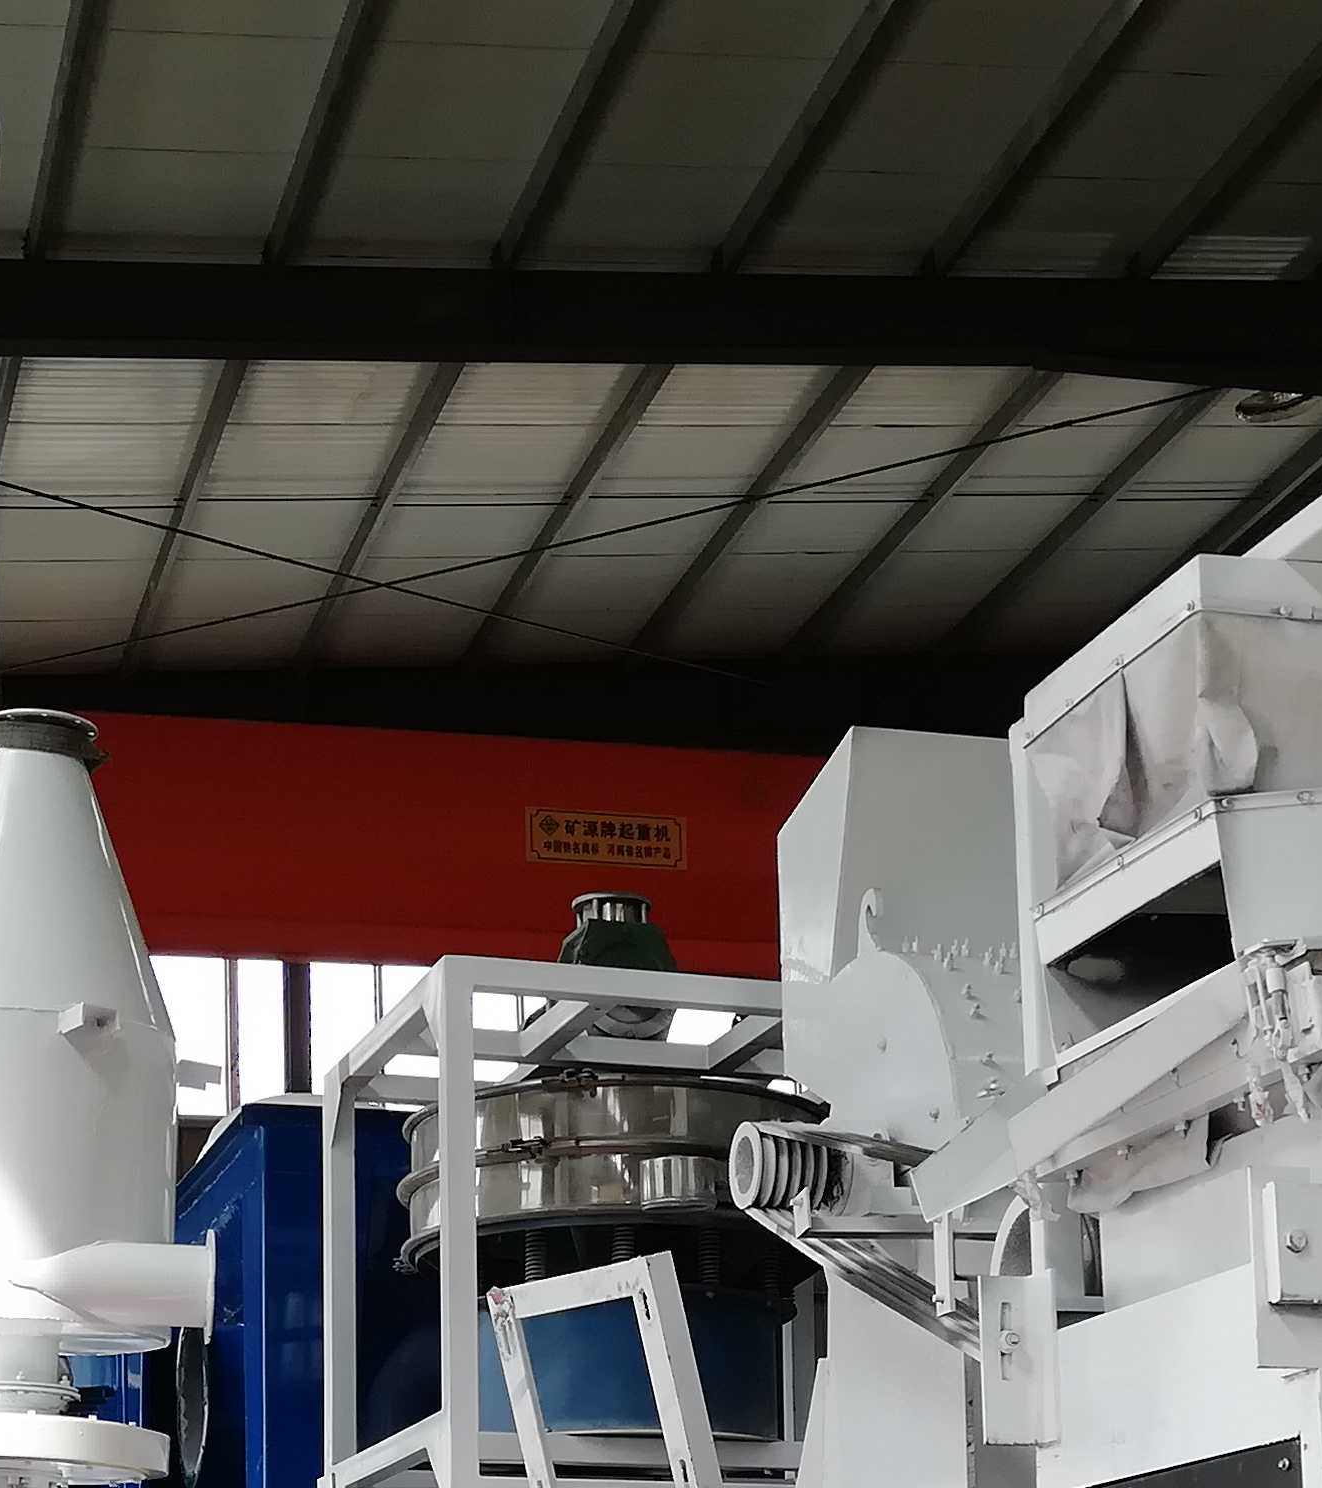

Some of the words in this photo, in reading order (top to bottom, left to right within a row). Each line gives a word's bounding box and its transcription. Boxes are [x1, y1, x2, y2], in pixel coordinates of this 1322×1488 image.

[564, 819, 671, 842] 矿源牌起重机
